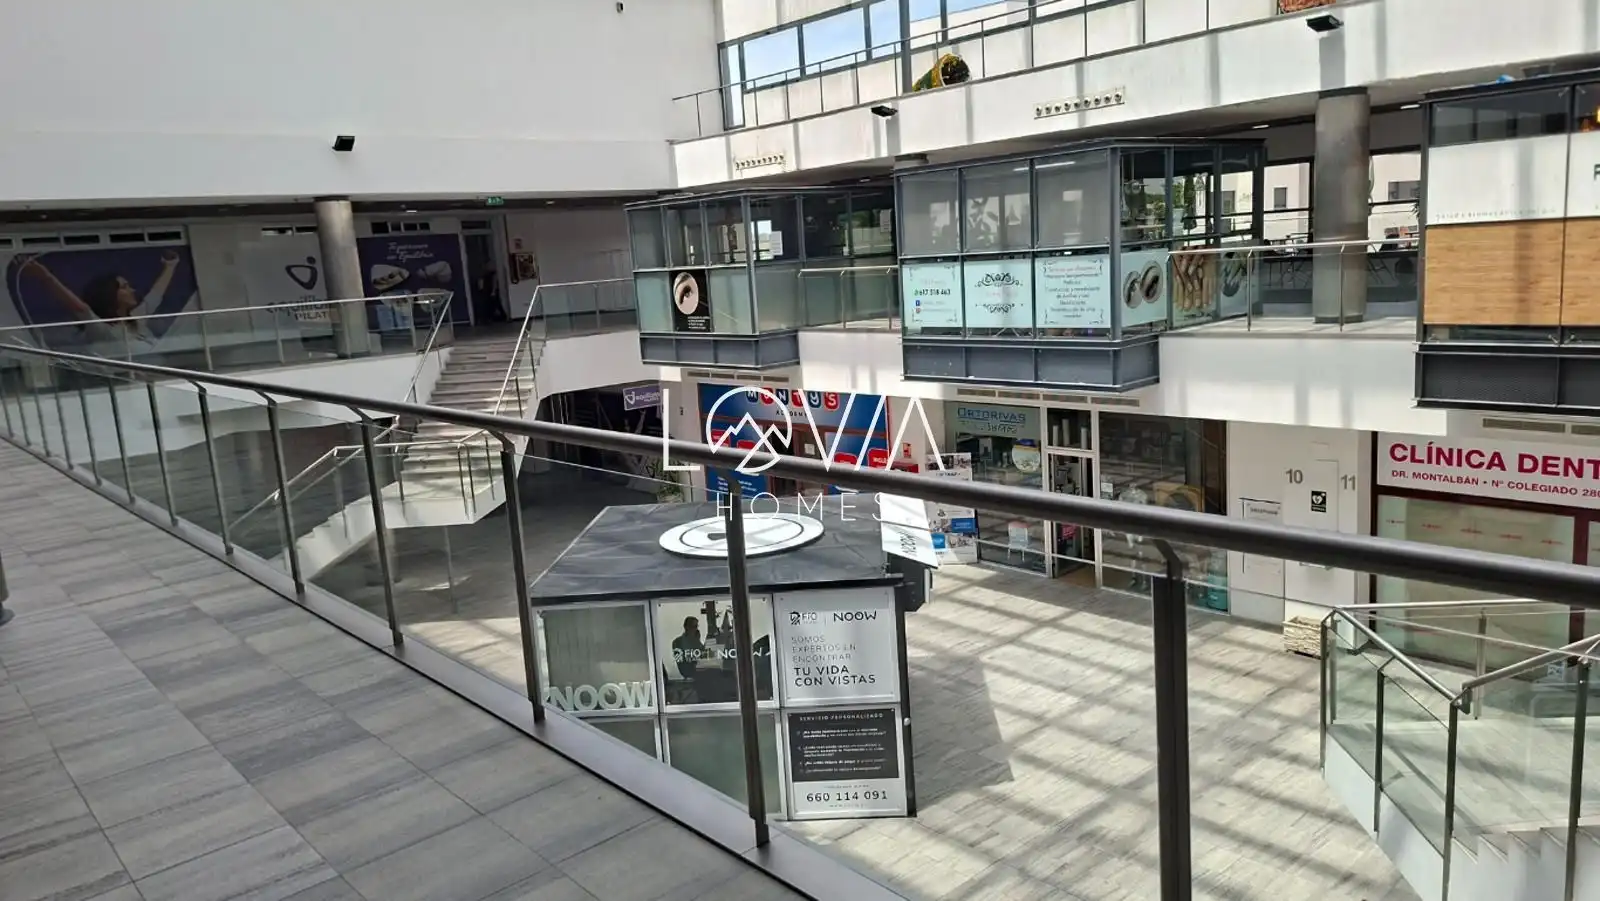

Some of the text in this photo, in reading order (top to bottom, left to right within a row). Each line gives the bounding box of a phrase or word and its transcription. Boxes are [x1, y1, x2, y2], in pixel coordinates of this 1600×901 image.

[1389, 441, 1507, 472] CLÍNICA
[1285, 468, 1304, 484] 10
[1340, 474, 1356, 491] 11
[1391, 469, 1409, 479] DR.
[1412, 472, 1479, 486] MONTALBÁN
[1507, 480, 1578, 496] COLEGIADO
[833, 610, 877, 622] NOOW
[793, 665, 850, 676] TU VIDA
[794, 674, 876, 687] CON VISTAS
[547, 680, 652, 711] NOOW
[806, 790, 888, 802] 660 114 091
